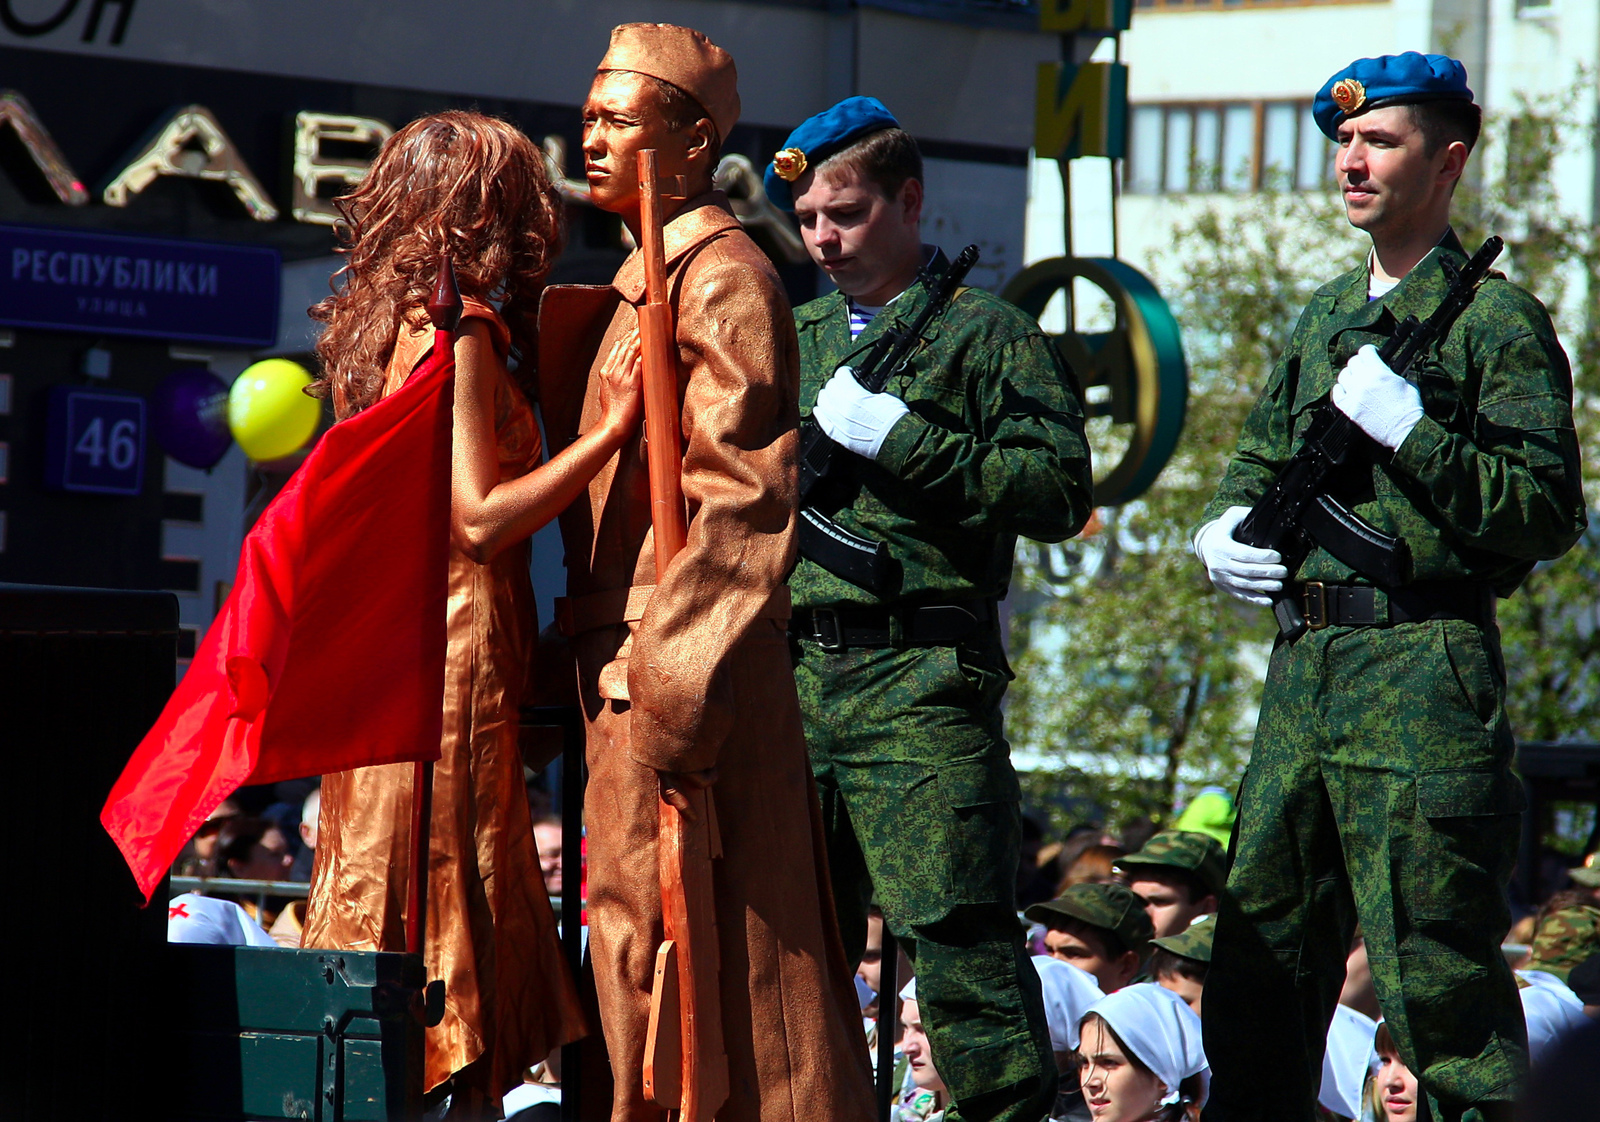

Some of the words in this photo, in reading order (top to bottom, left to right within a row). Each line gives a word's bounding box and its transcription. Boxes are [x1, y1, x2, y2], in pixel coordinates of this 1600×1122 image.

[12, 249, 219, 296] РЕСПУБЛИКИ
[76, 297, 148, 317] УЛИЦА
[74, 417, 136, 470] 46
